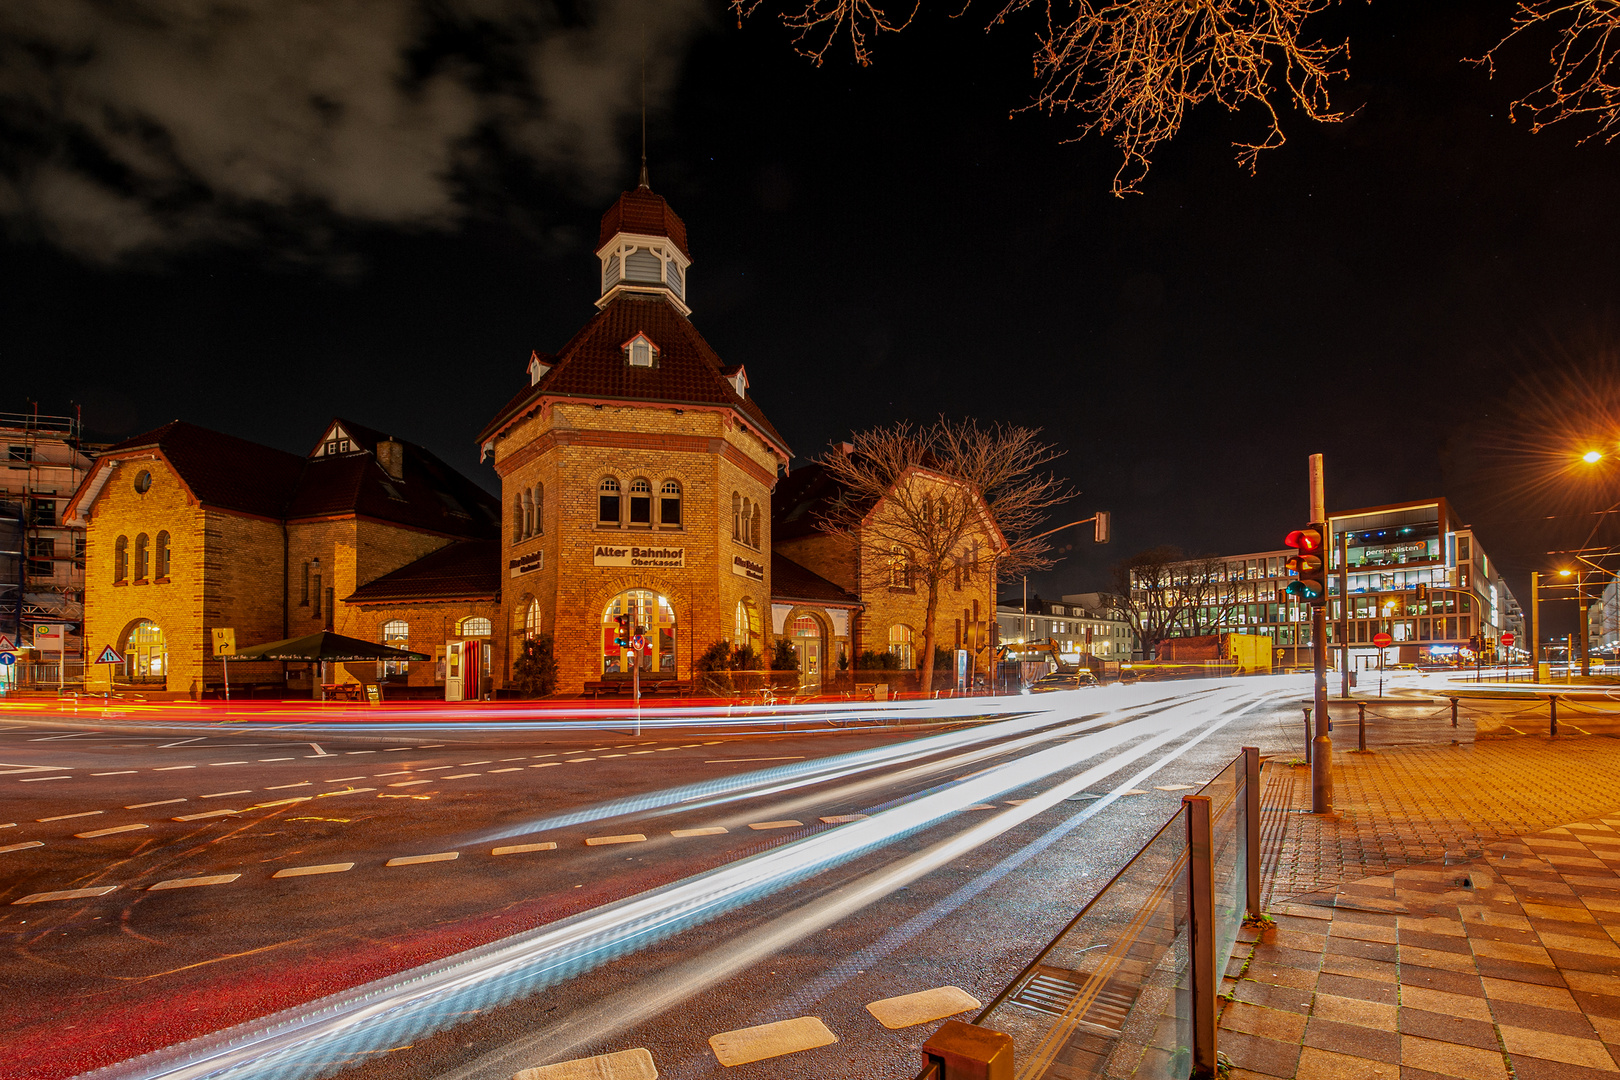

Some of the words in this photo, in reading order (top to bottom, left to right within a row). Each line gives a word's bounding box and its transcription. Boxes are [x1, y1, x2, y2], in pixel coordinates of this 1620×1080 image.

[595, 546, 628, 557] Alter
[631, 547, 684, 559] Bahnhof
[1366, 545, 1419, 556] personalisten
[631, 558, 683, 567] Oberkassel
